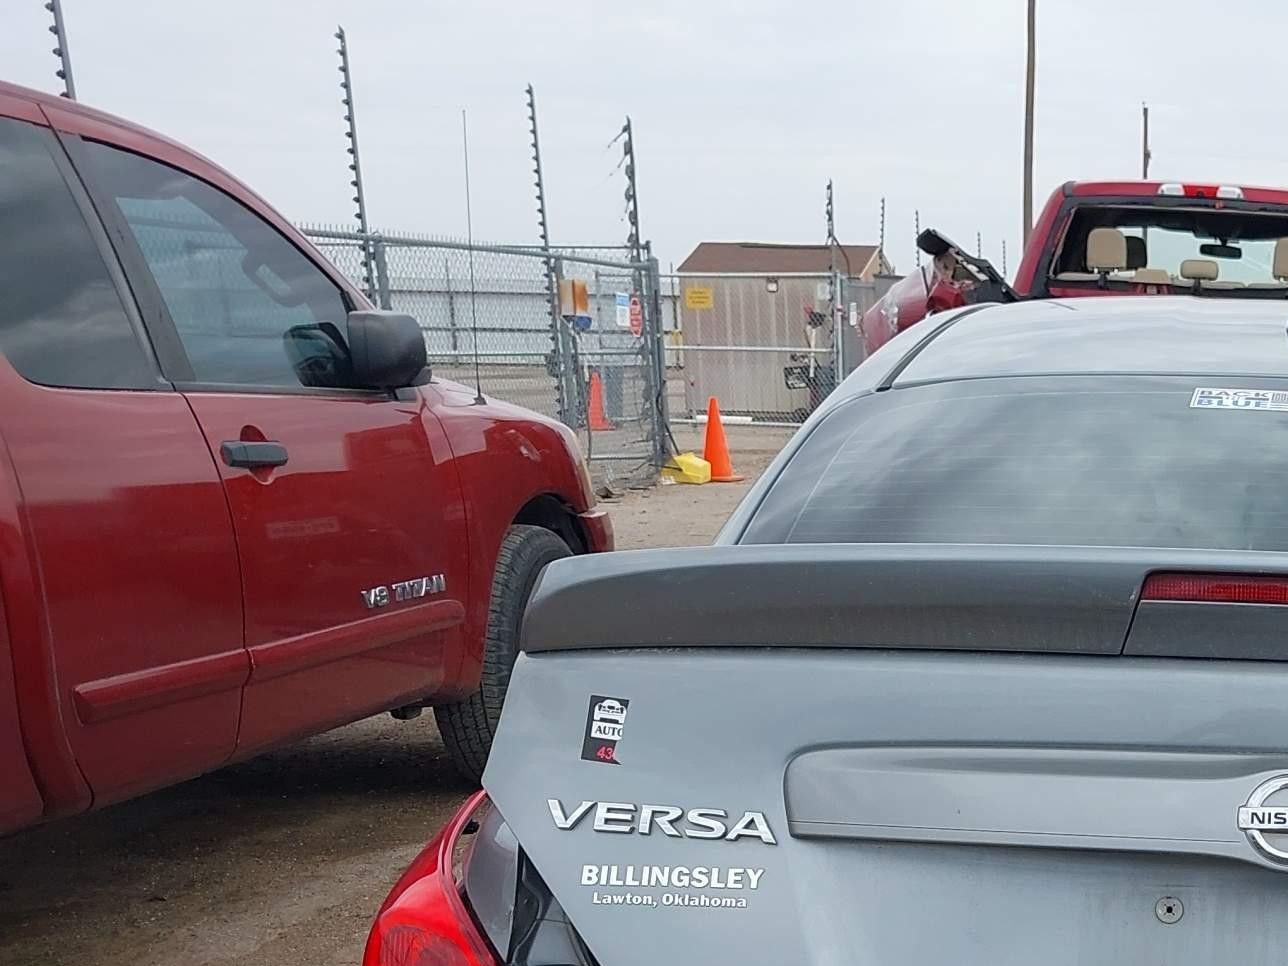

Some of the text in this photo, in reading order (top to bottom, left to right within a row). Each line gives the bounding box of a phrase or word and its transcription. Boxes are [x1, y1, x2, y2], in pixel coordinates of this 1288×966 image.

[392, 573, 446, 601] TITAN
[596, 746, 614, 760] 43
[548, 799, 778, 846] VERSA
[580, 864, 765, 889] BILLINGSLEY
[592, 891, 747, 908] Lawton, Oklahoma
